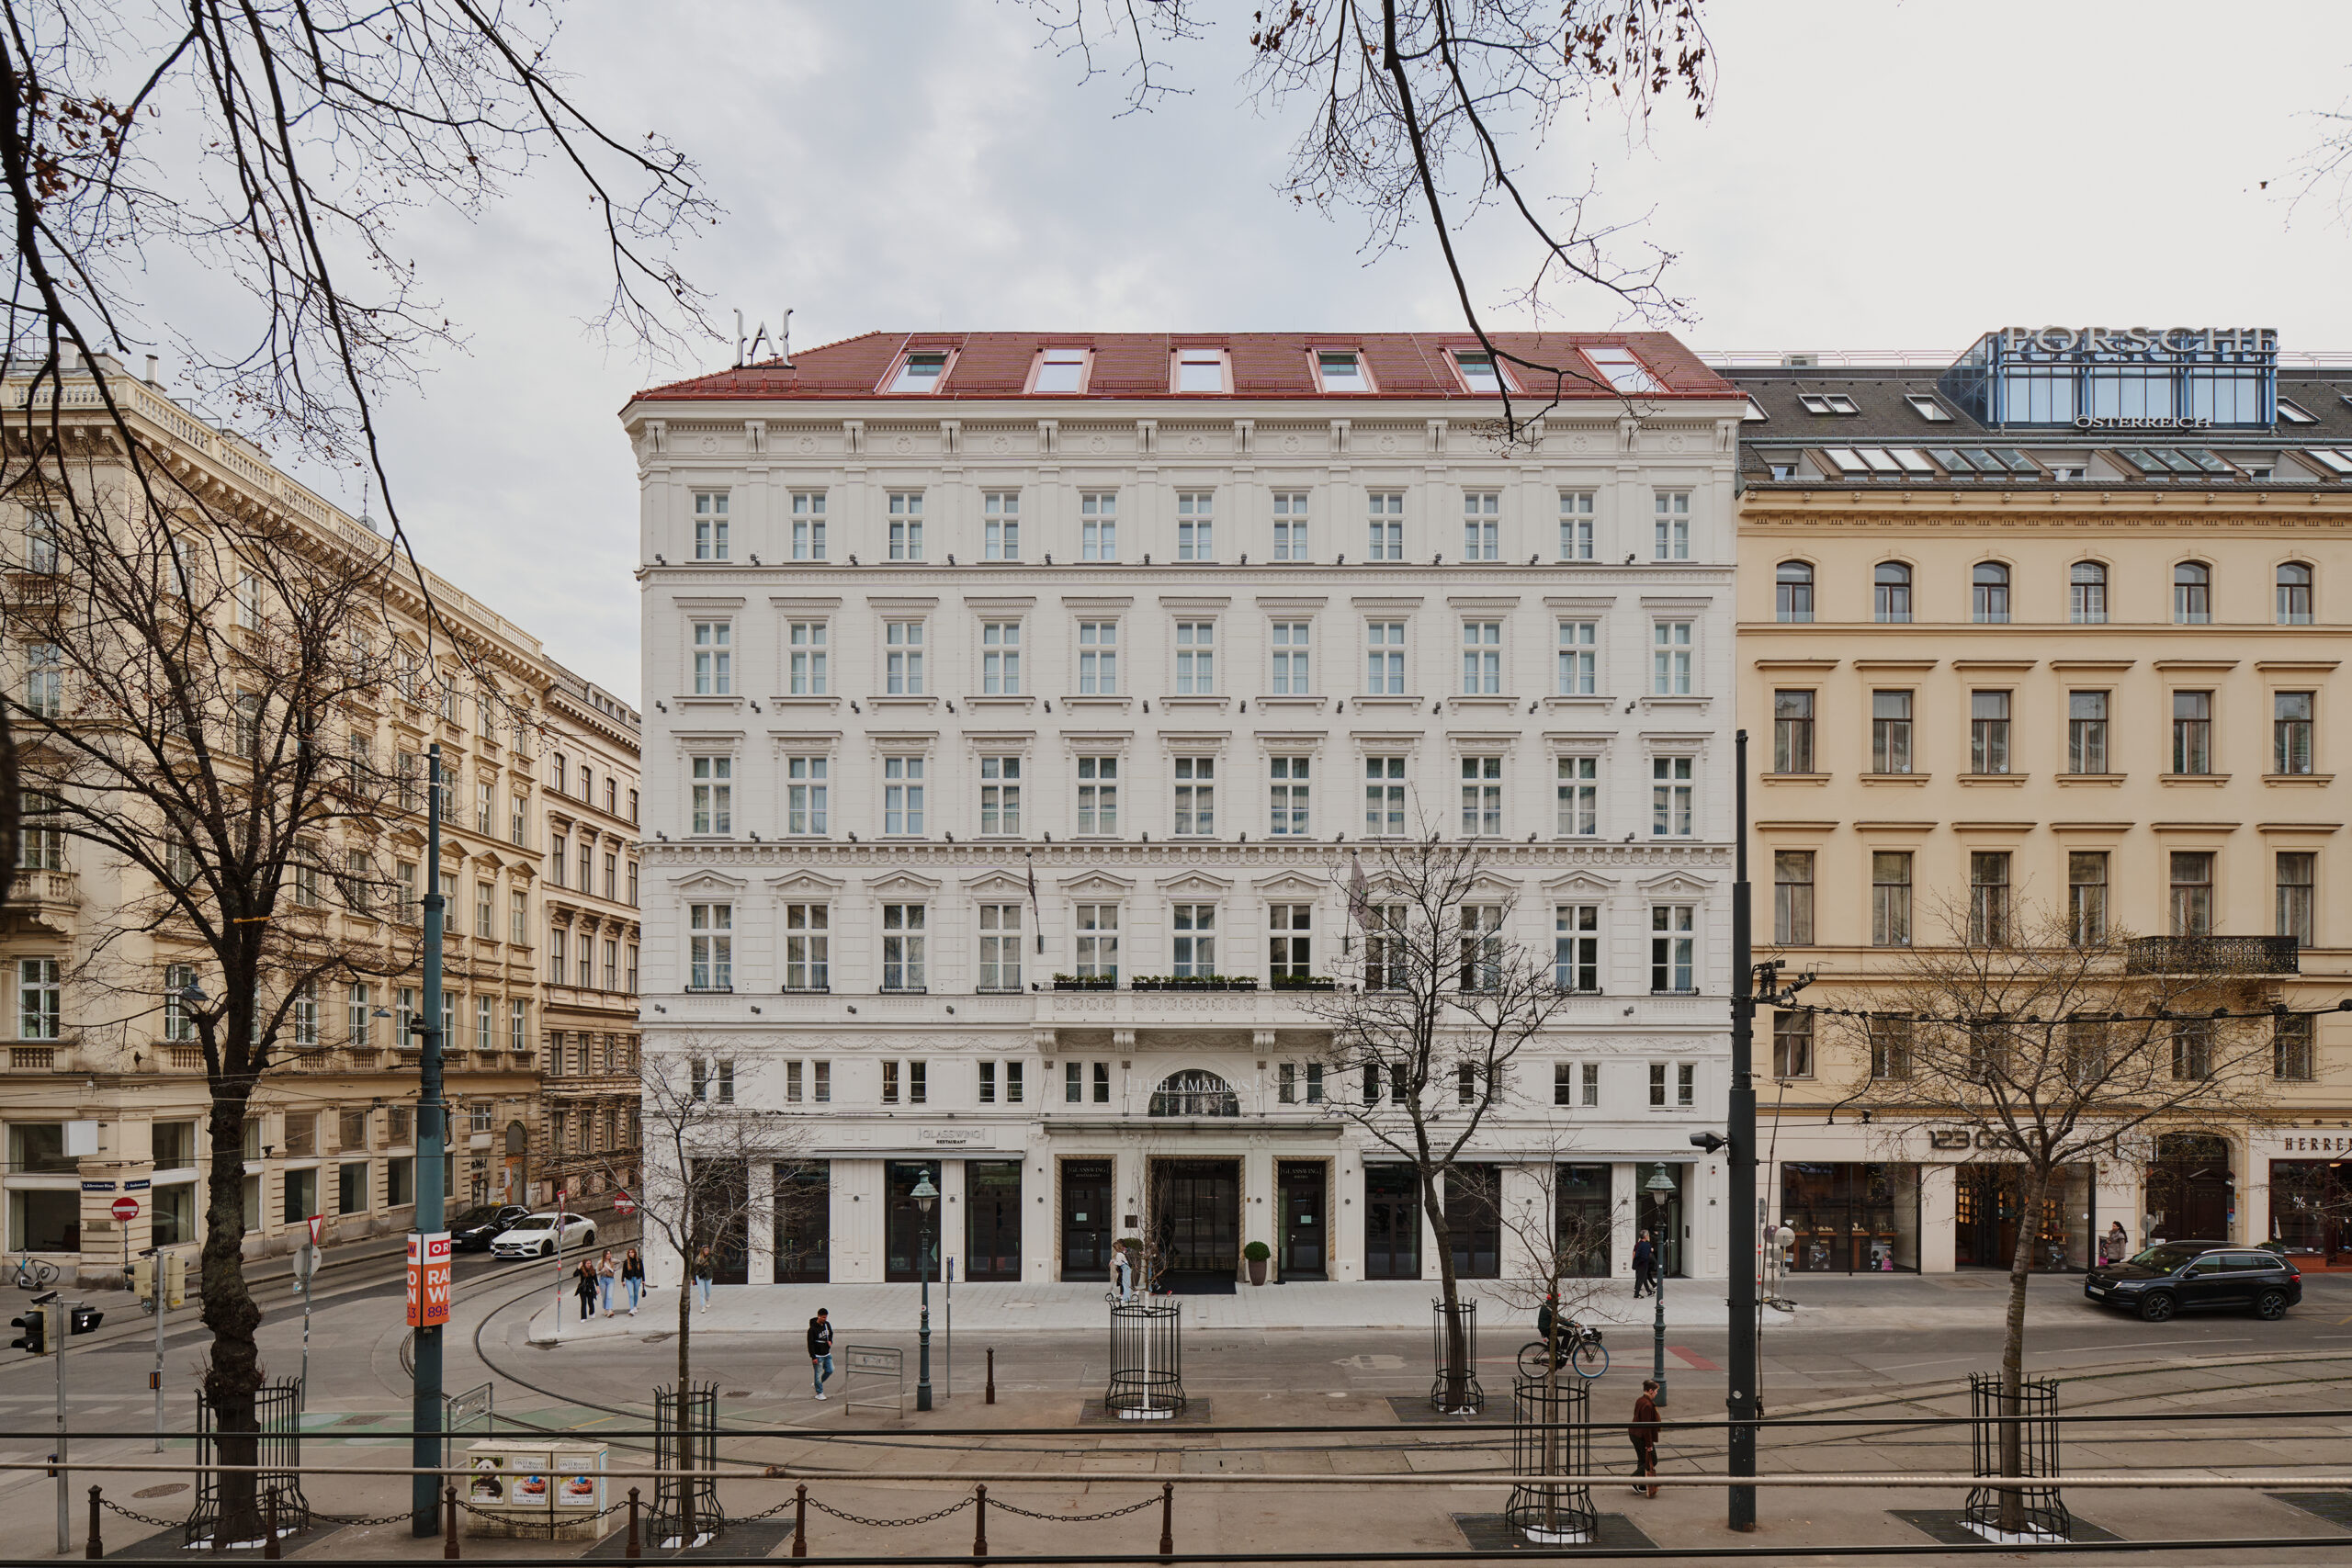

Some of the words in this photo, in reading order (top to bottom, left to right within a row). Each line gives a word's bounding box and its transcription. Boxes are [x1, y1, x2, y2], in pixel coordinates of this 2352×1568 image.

[2004, 325, 2280, 353] PORSCHE
[2074, 414, 2211, 428] ÖSTERREICH
[1134, 1078, 1169, 1092] THE
[1176, 1078, 1250, 1092] AMAURIS
[2285, 1138, 2352, 1150] HERRE
[428, 1304, 448, 1317] 89.9
